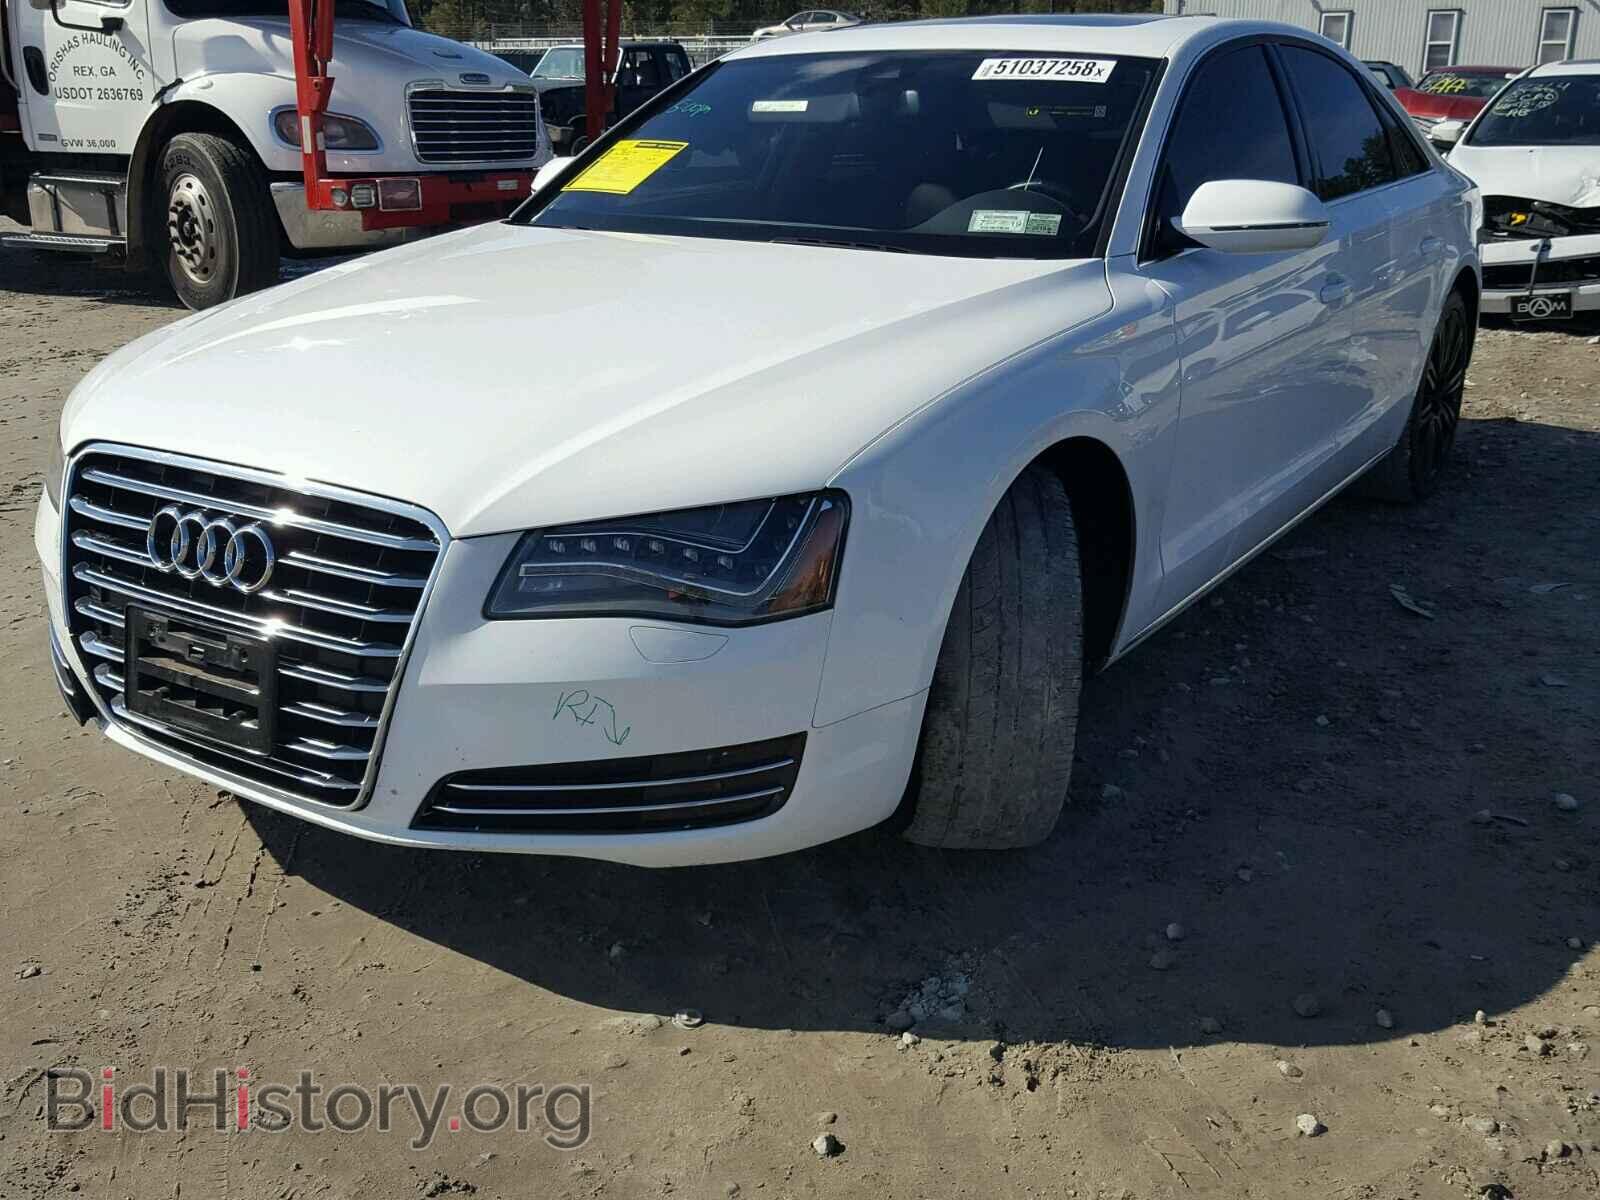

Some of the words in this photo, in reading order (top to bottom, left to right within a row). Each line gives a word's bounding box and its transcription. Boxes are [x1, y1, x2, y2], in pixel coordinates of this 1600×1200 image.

[48, 35, 80, 82] ORISHAS
[81, 33, 126, 58] HAULING
[127, 54, 145, 85] INC.
[73, 65, 98, 78] REX,
[100, 65, 117, 77] GA
[54, 87, 93, 99] USDOT
[97, 88, 144, 101] 2636769
[61, 138, 84, 147] GVW
[86, 138, 117, 149] 36,000
